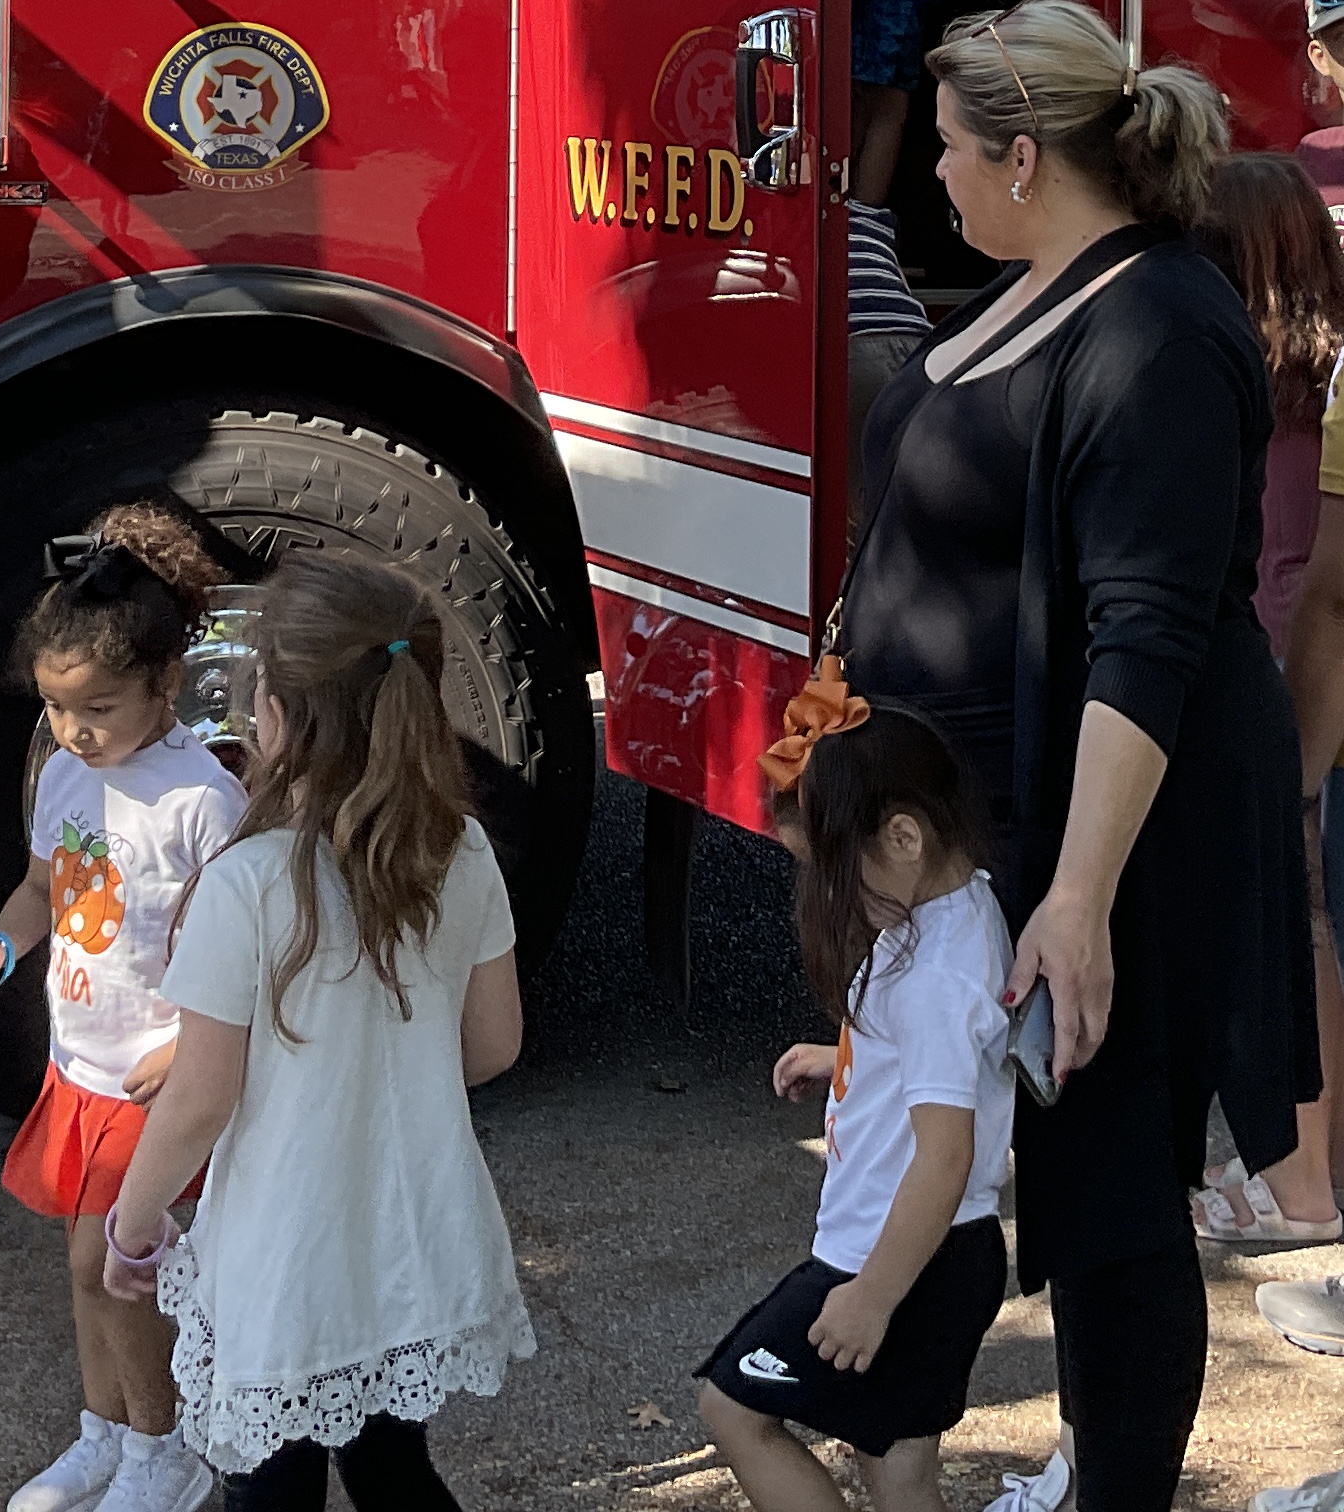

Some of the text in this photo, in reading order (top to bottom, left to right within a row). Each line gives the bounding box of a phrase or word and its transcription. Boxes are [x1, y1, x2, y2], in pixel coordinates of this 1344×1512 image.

[158, 41, 208, 96] WICHITA
[209, 32, 254, 48] FALLS
[258, 35, 290, 61] FIRE
[214, 152, 260, 165] TEXAS
[239, 135, 261, 148] 1891
[186, 165, 216, 187] ISO
[219, 172, 274, 189] CLASS
[564, 135, 755, 240] W.F.F.D.
[51, 946, 93, 1008] Mia
